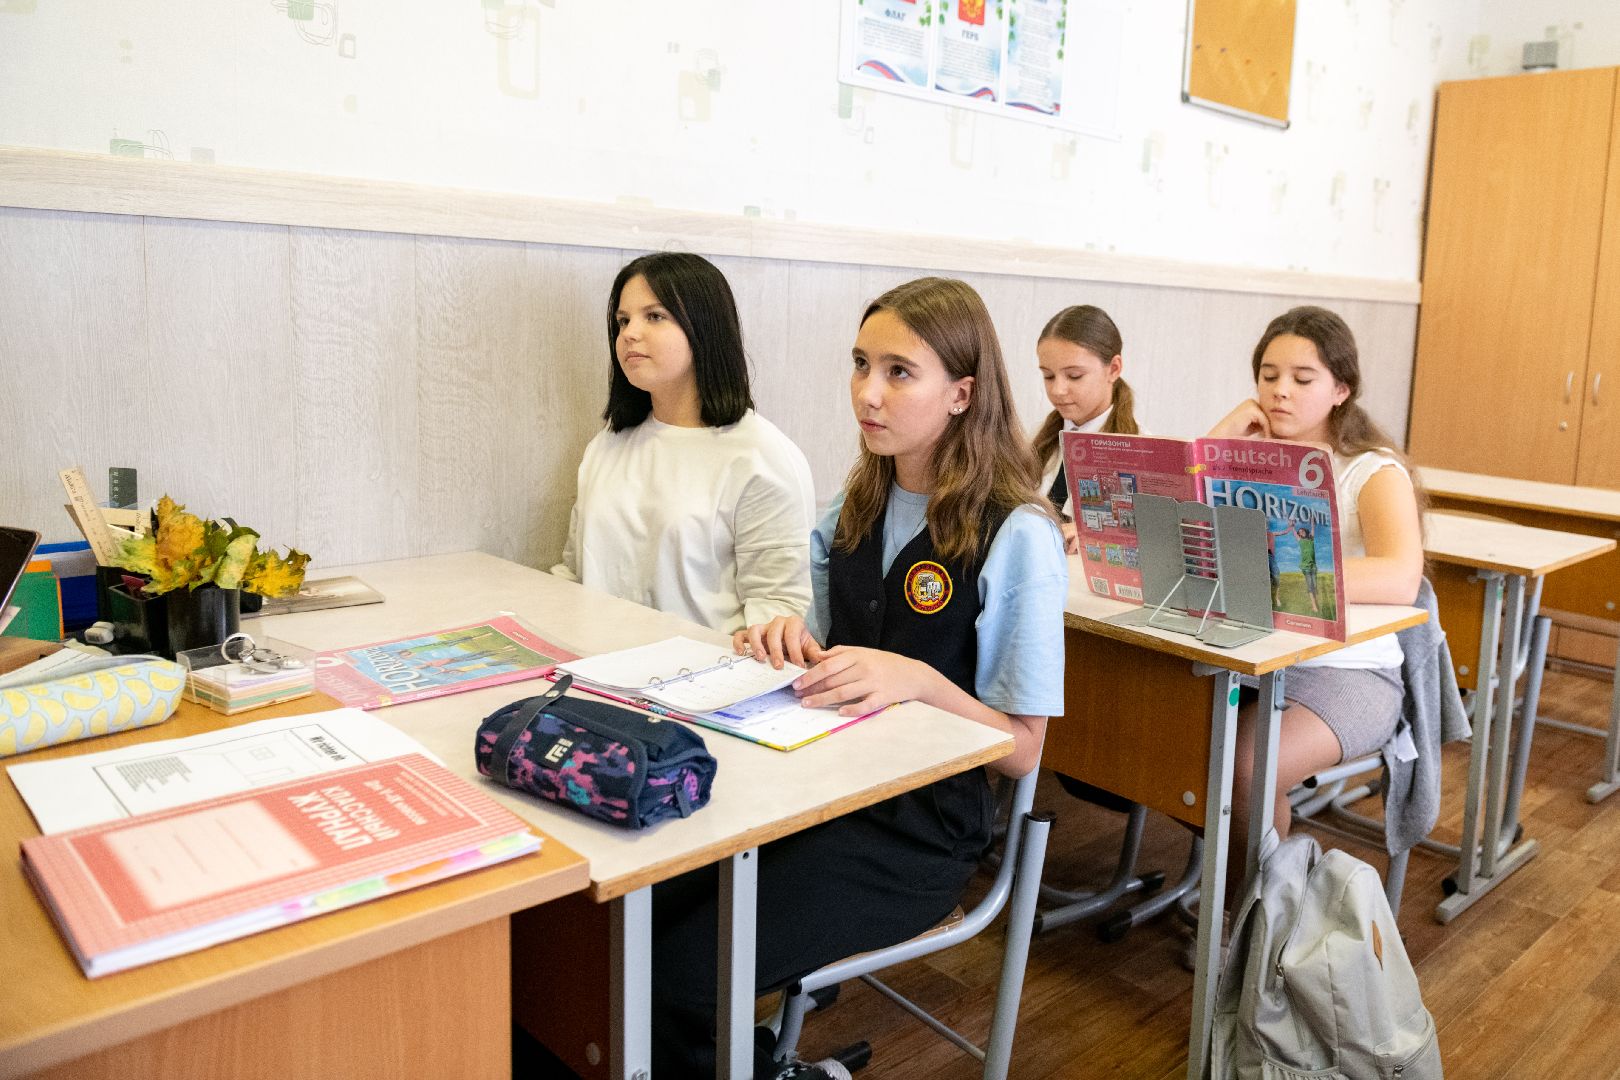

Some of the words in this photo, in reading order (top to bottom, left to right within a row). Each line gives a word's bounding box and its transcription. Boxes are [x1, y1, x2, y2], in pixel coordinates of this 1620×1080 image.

[1090, 439, 1131, 447] ГОРИЗОНТЫ
[1203, 443, 1292, 468] Deutsch
[1298, 449, 1325, 490] 6
[1203, 475, 1330, 527] HORIZONTE
[287, 791, 374, 850] ЖУРНАЛ
[319, 785, 400, 841] КЛАССНЫЙ
